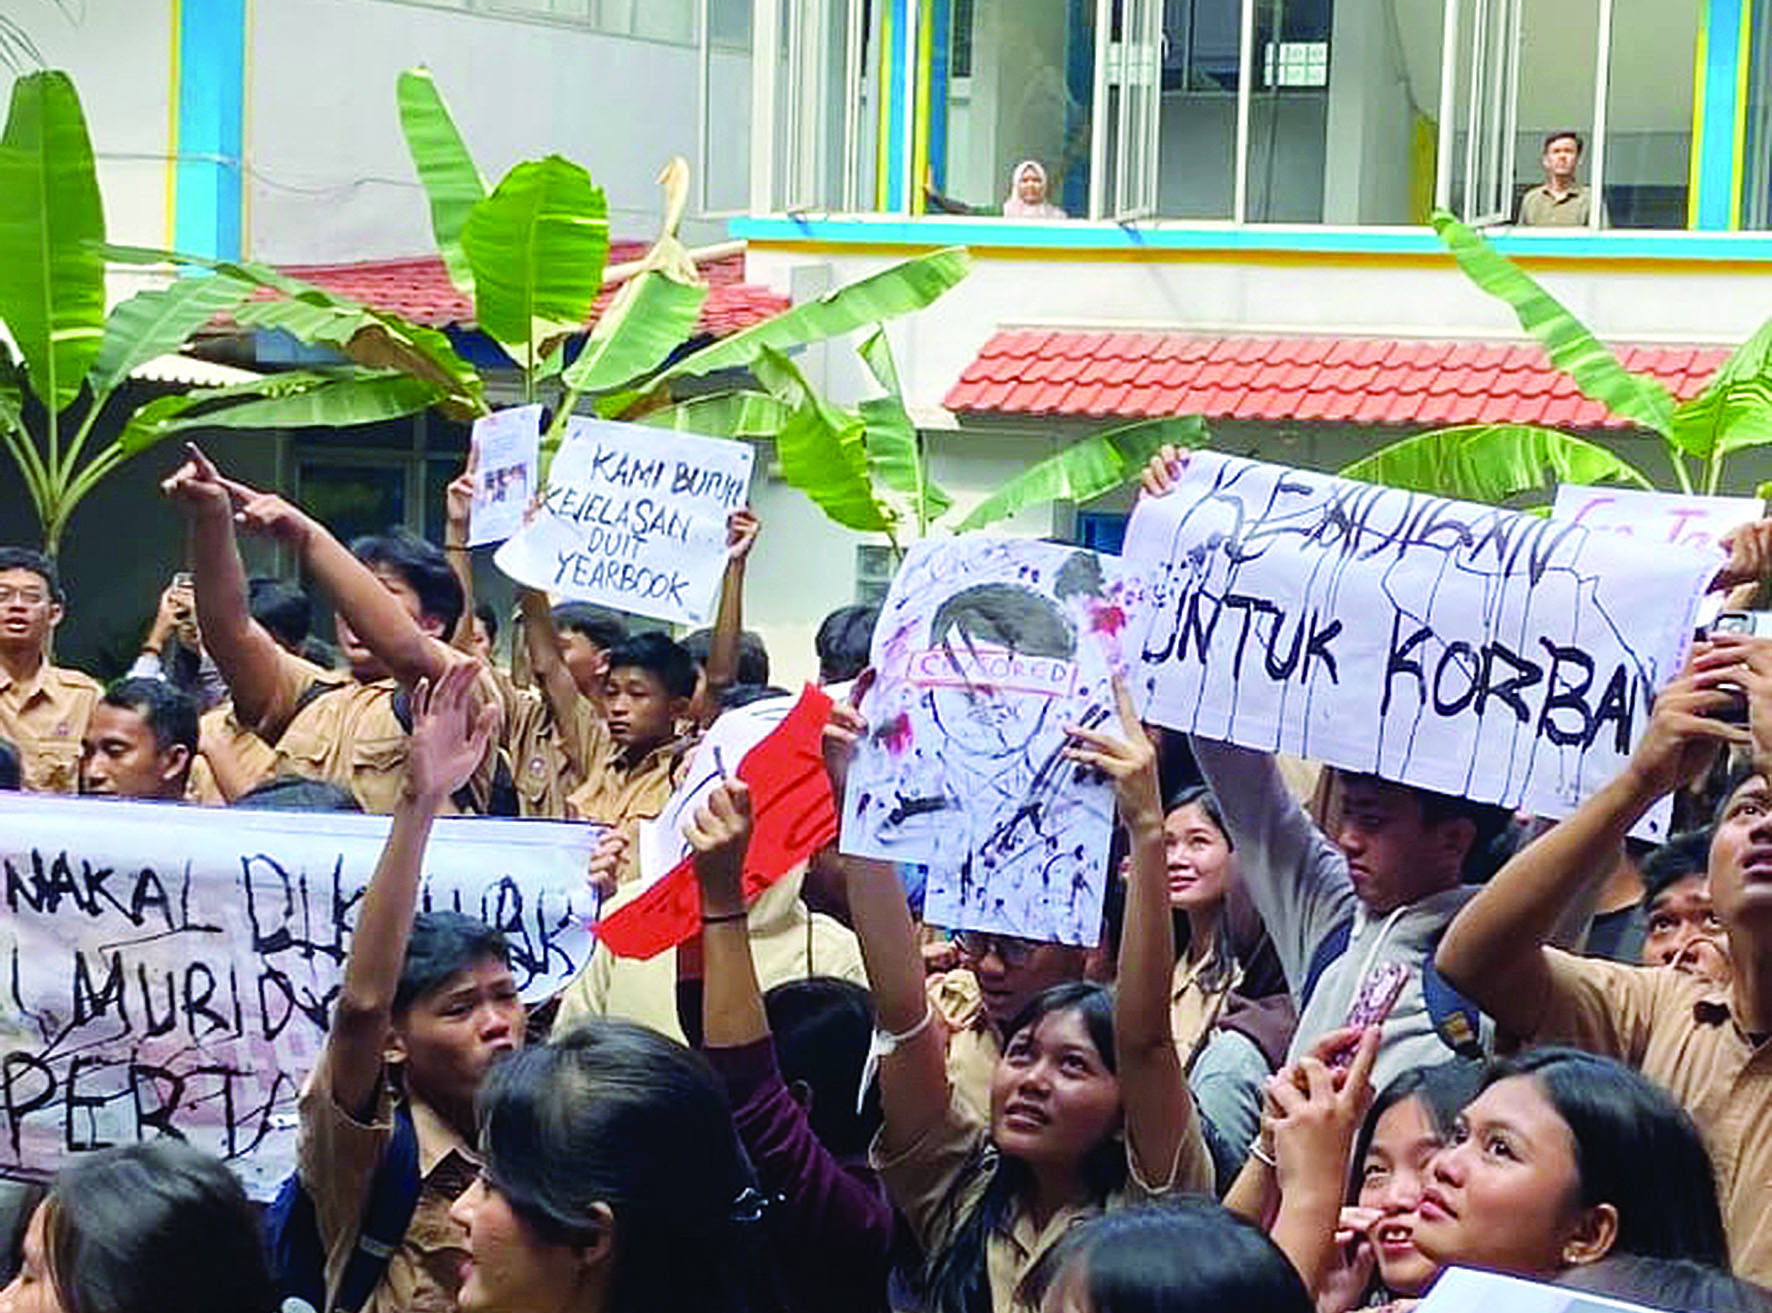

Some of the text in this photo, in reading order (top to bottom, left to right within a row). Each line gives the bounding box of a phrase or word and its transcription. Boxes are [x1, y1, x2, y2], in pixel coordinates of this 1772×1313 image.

[590, 443, 666, 489] KAMI
[541, 486, 692, 542] KEJELASAN
[587, 526, 648, 559] DUIT
[553, 550, 690, 606] YEARBOOK
[1141, 576, 1344, 685] UNTUK
[4, 848, 224, 934] NAKAL
